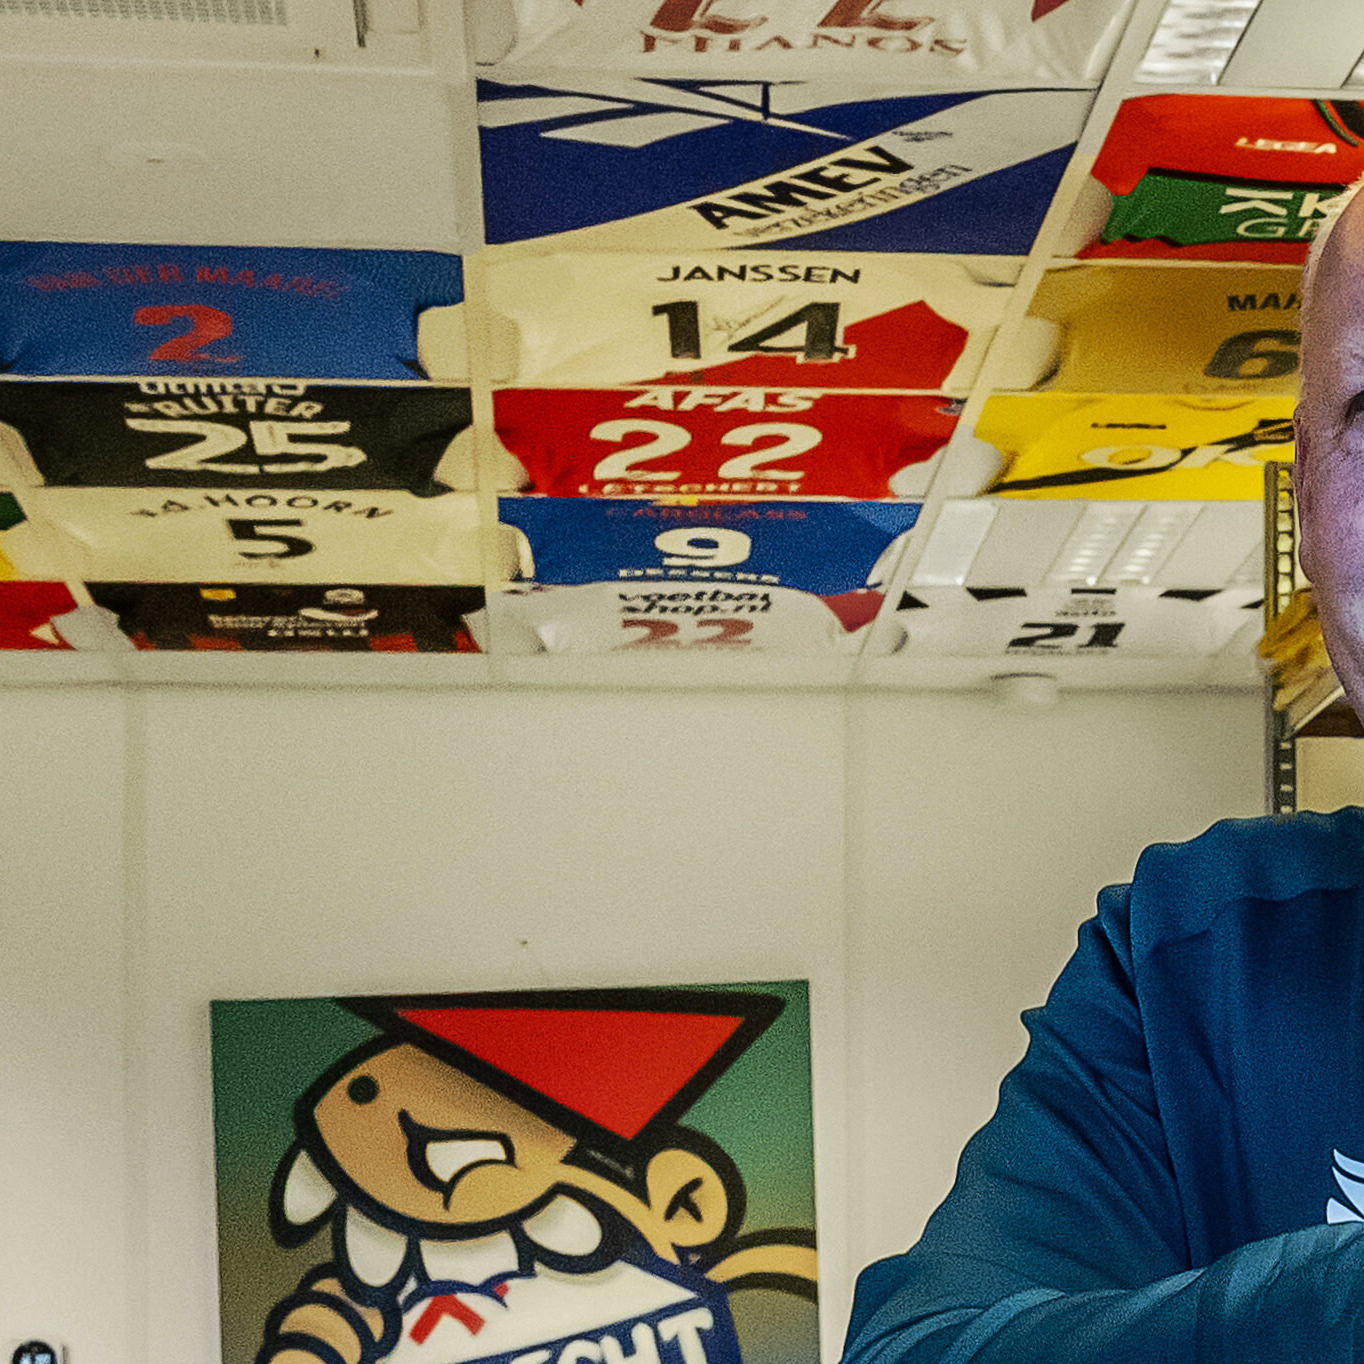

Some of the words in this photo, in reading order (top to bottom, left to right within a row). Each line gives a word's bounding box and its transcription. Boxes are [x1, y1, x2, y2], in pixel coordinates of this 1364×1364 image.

[687, 146, 914, 229] AMEV
[657, 264, 861, 284] JANSSEN
[133, 304, 243, 363] 2
[651, 300, 857, 364] 14
[1205, 329, 1302, 379] 6
[623, 390, 823, 412] AFAS
[124, 417, 367, 474] 25
[589, 418, 824, 481] 22
[227, 519, 316, 559] 5
[654, 527, 752, 567] 9
[618, 618, 755, 649] 22
[1007, 623, 1126, 649] 21
